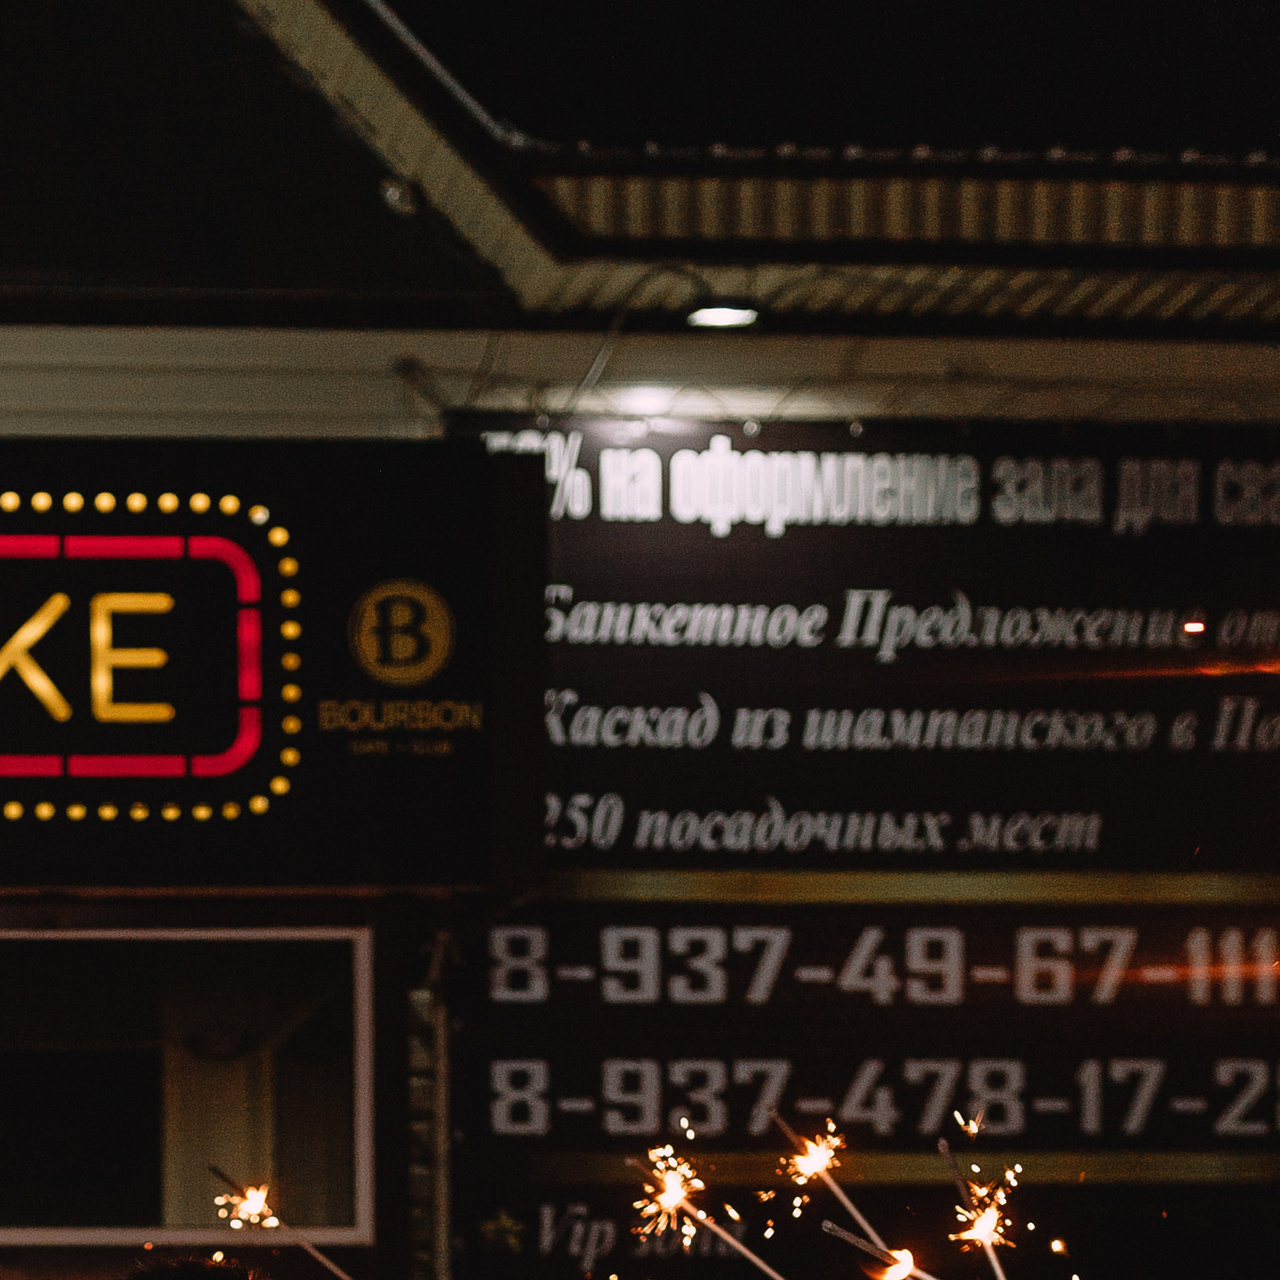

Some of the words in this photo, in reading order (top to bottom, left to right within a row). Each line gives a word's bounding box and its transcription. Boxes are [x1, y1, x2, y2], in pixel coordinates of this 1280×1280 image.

[599, 448, 663, 522] на
[670, 434, 980, 538] оформление
[991, 455, 1105, 525] зала
[1112, 456, 1201, 536] для
[318, 699, 485, 733] BOURBON
[730, 706, 793, 751] из
[801, 707, 1159, 752] шампанского
[633, 794, 953, 853] посадочных
[956, 812, 1105, 853] мест
[489, 1057, 1280, 1137] 8-937-478-17-2
[538, 1202, 617, 1273] Vip
